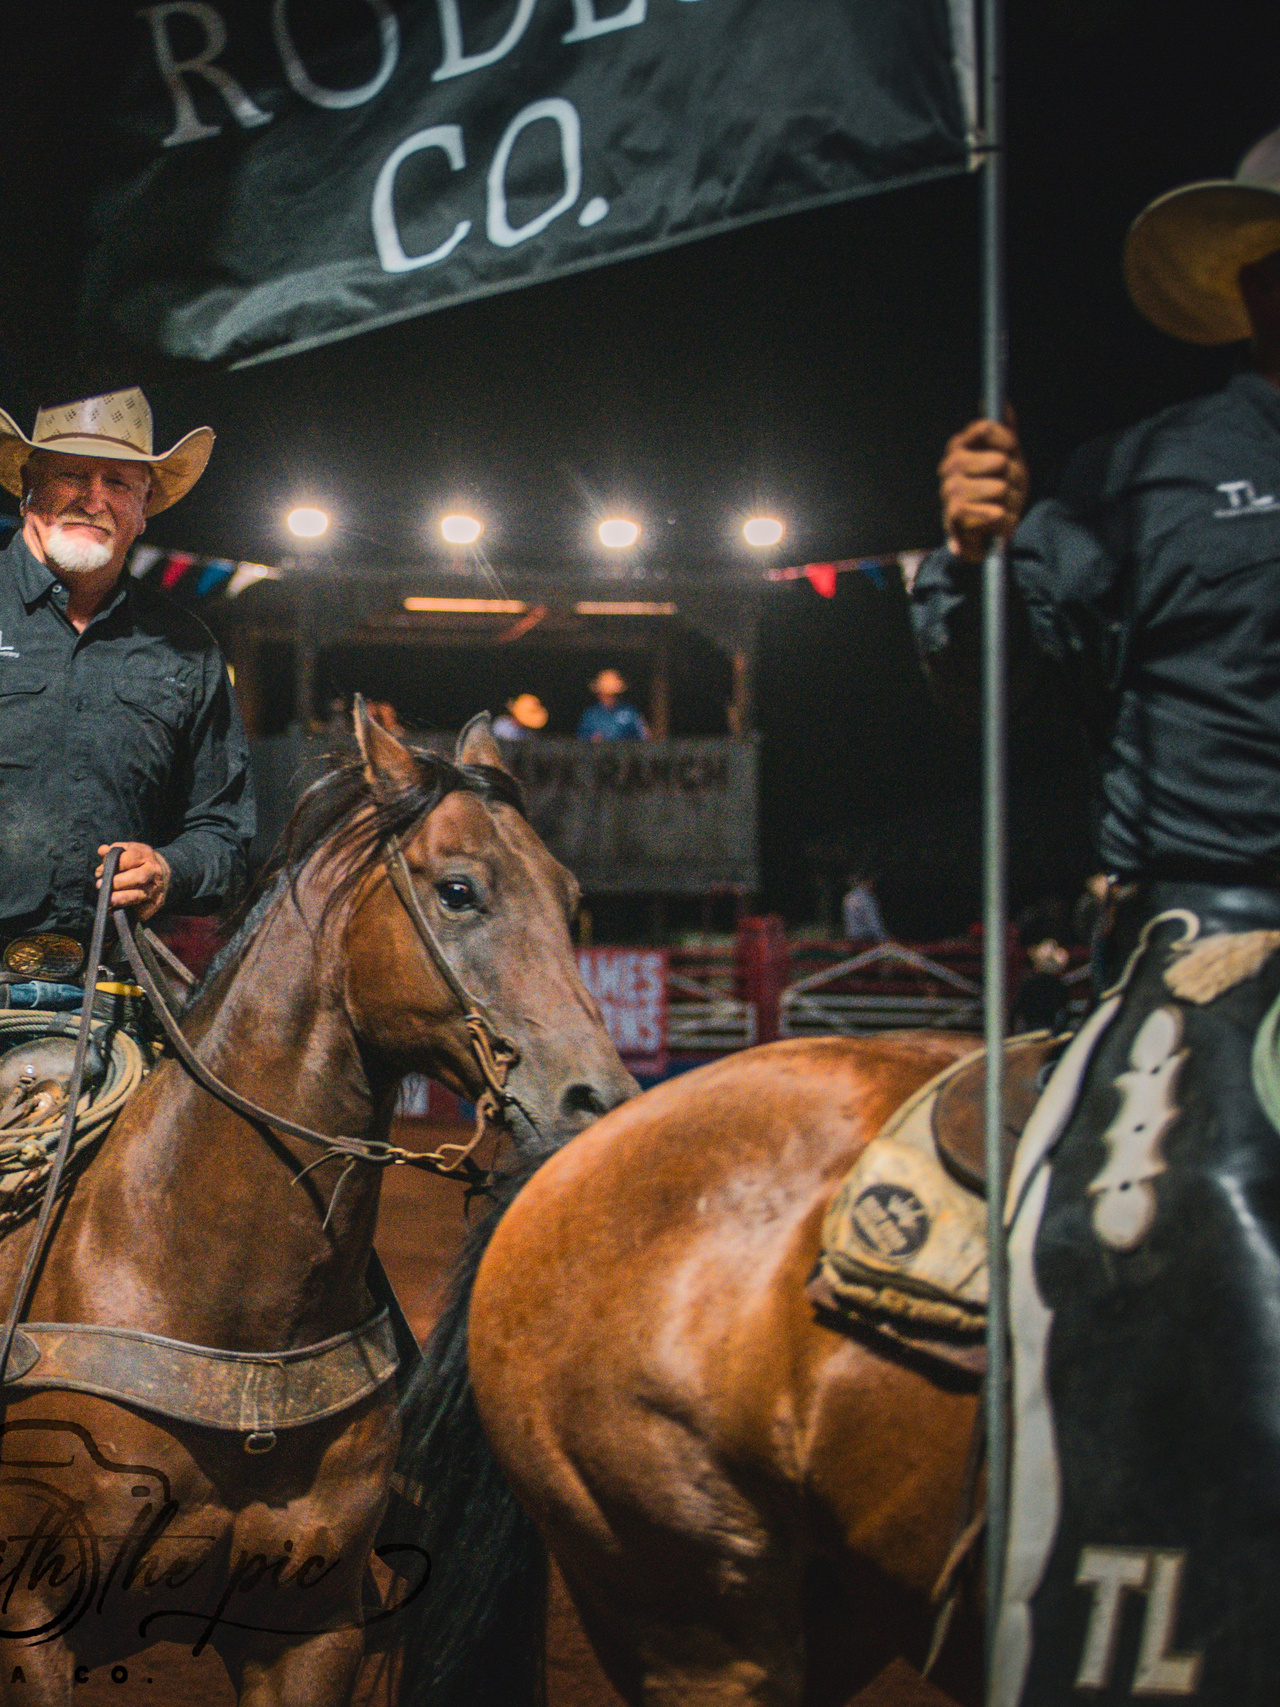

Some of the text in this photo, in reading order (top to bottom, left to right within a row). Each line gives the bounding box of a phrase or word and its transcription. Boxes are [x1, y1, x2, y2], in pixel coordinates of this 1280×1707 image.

[371, 97, 610, 273] CO.
[1216, 481, 1274, 508] TL
[1073, 1547, 1205, 1697] TL
